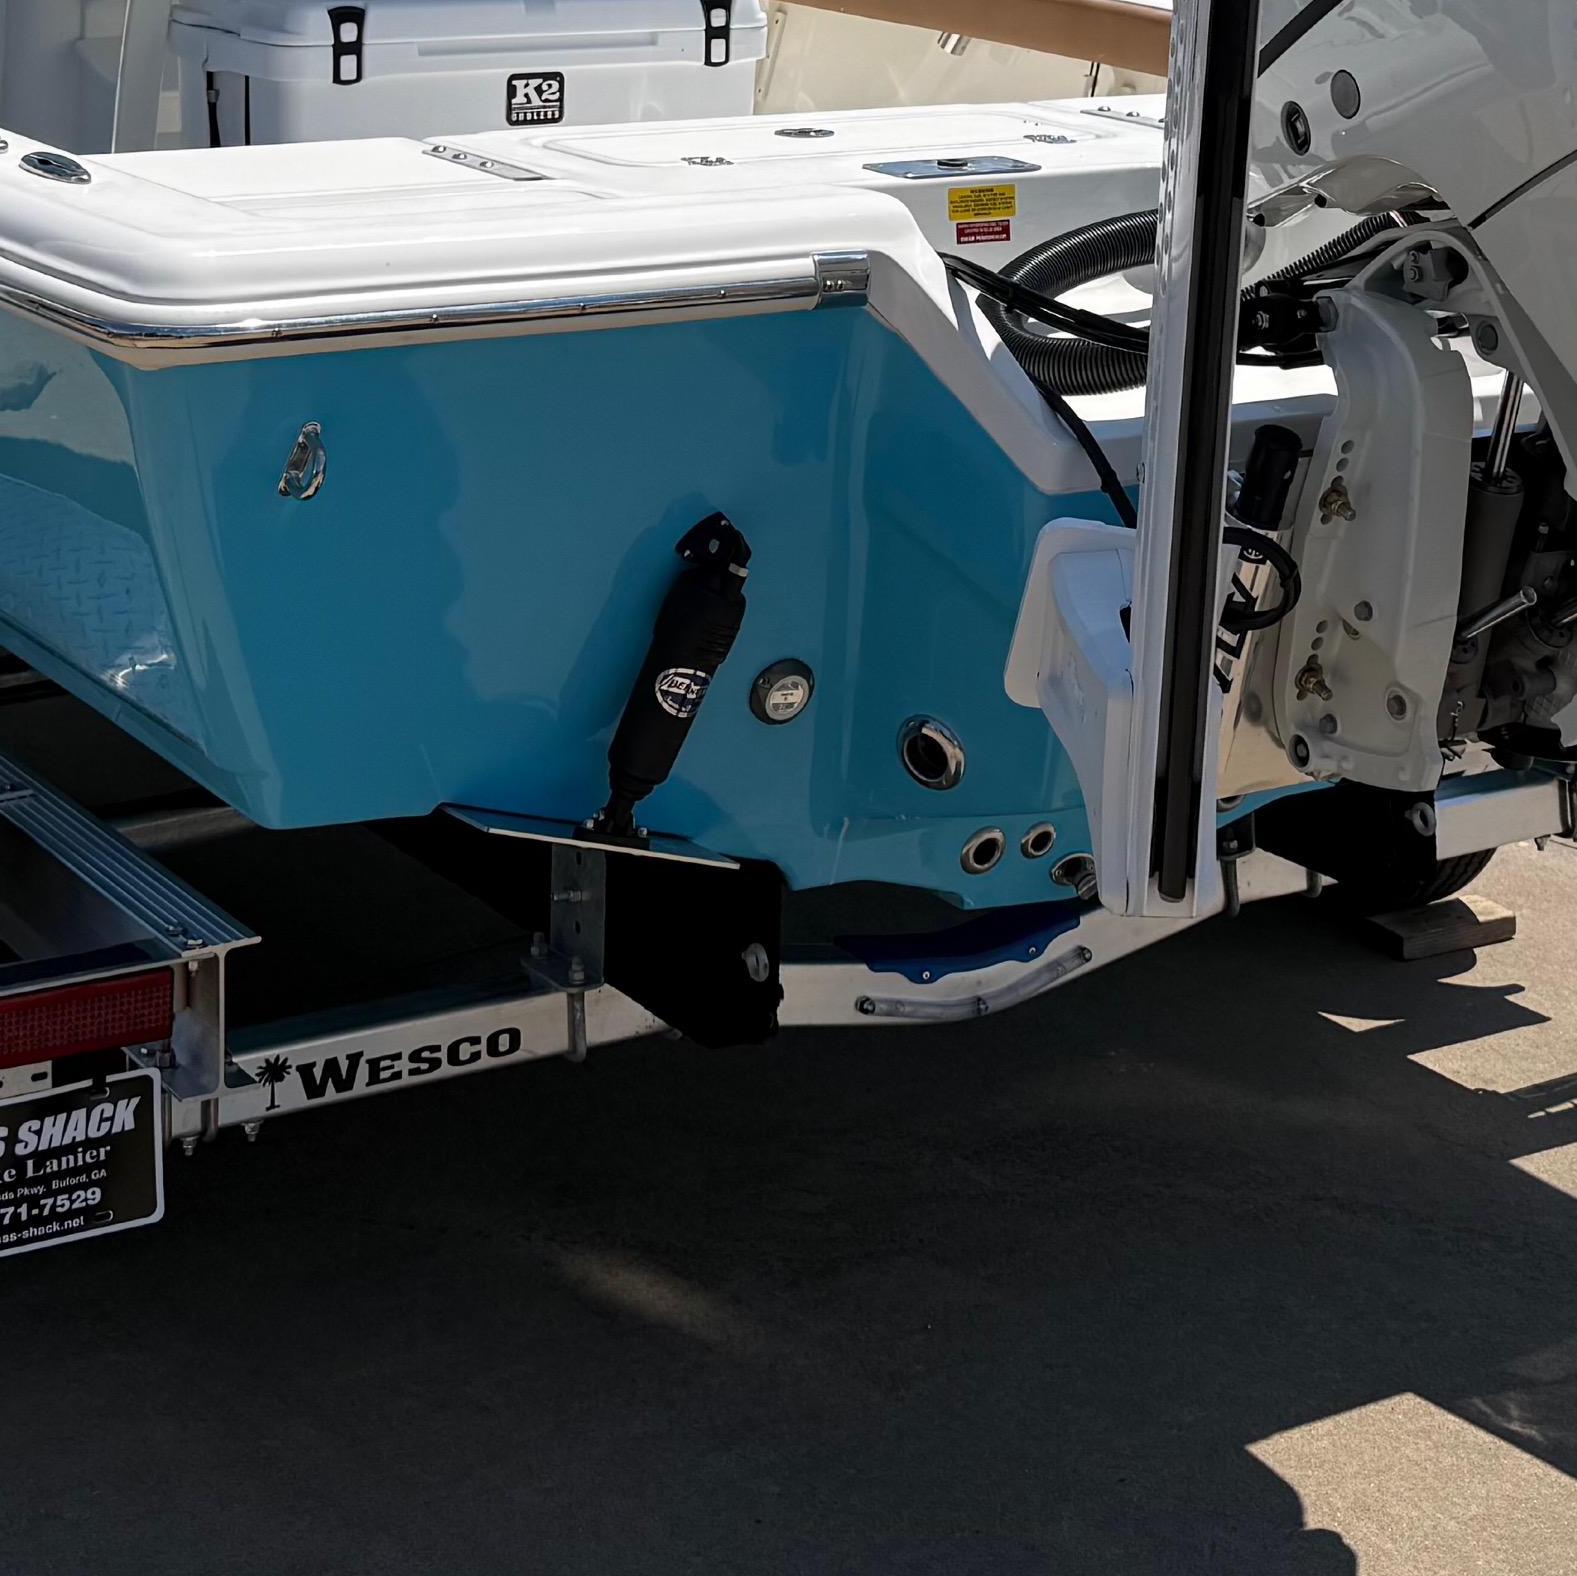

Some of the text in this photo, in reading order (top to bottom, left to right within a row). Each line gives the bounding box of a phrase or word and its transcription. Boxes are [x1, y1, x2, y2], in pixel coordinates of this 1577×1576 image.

[512, 78, 560, 104] K2
[15, 1096, 141, 1155] SHACK
[26, 1145, 111, 1179] Lanier
[17, 1185, 46, 1200] Pkwy.
[52, 1173, 89, 1190] Buford,
[91, 1169, 107, 1179] GA
